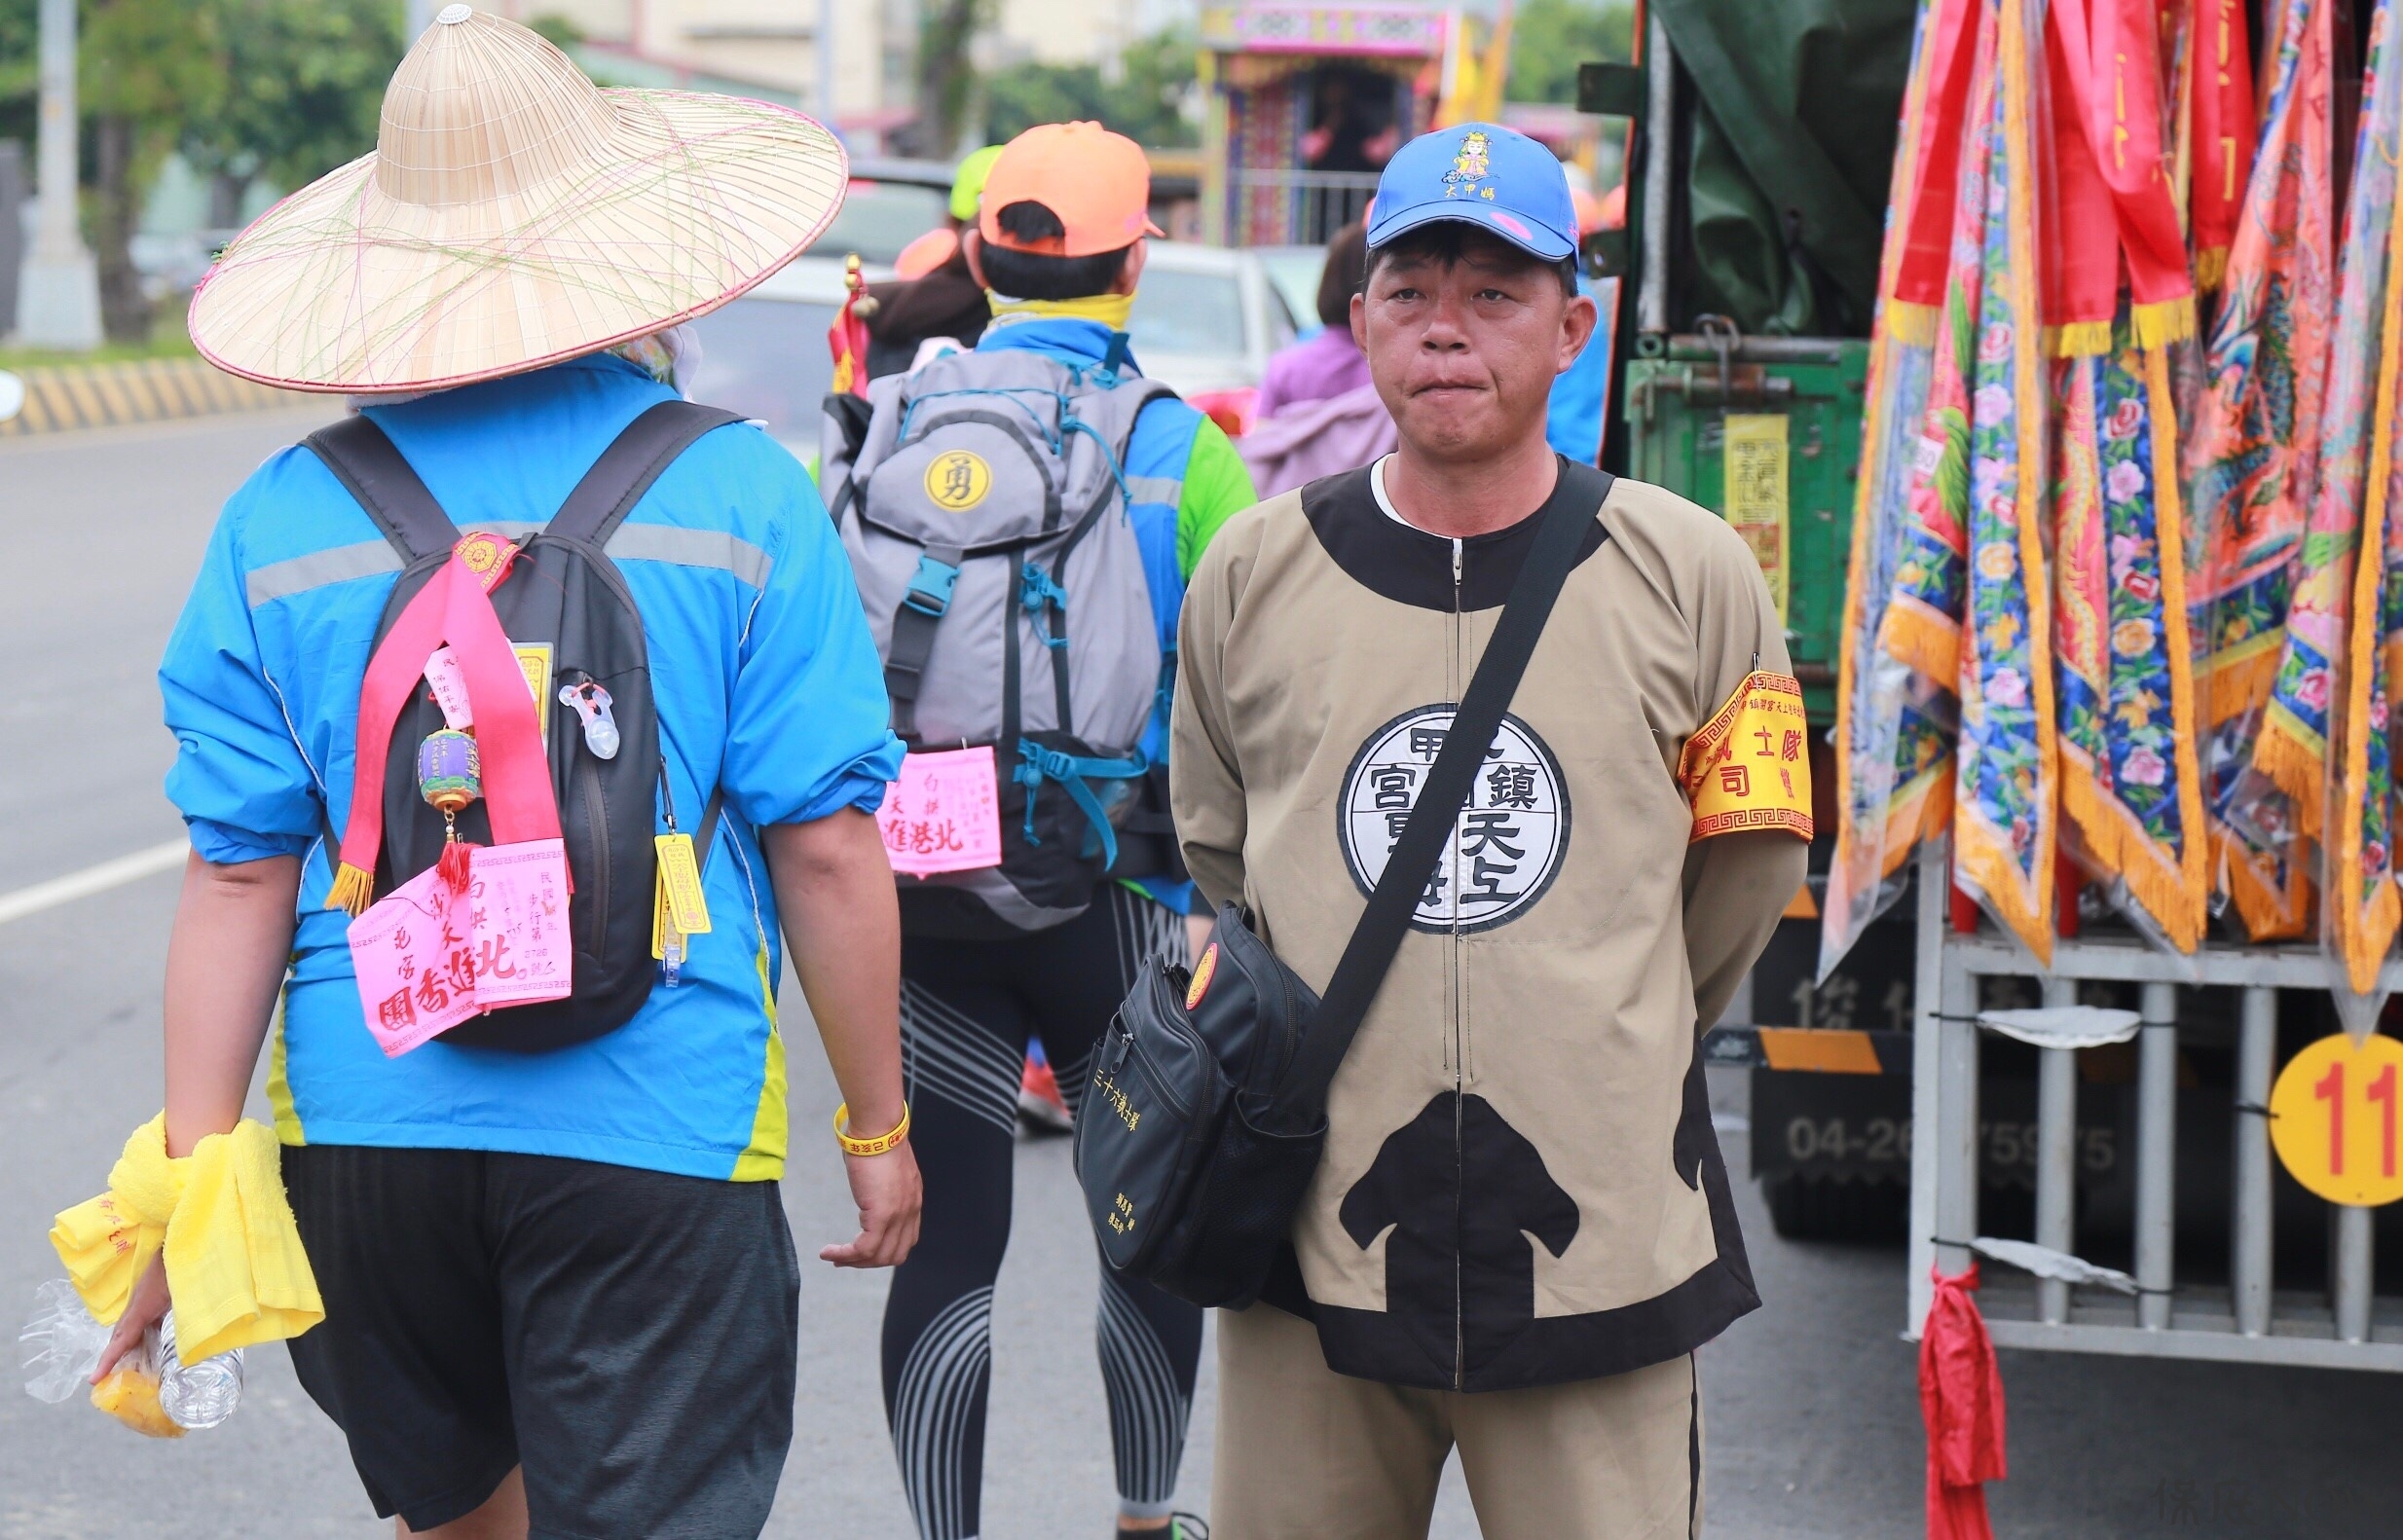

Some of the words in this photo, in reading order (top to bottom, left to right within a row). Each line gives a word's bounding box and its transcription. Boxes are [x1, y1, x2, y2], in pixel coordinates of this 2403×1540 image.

[1444, 183, 1496, 201] 大甲媽
[942, 458, 972, 500] 勇
[1370, 763, 1538, 810] 鎮宮
[2313, 1061, 2397, 1178] 11
